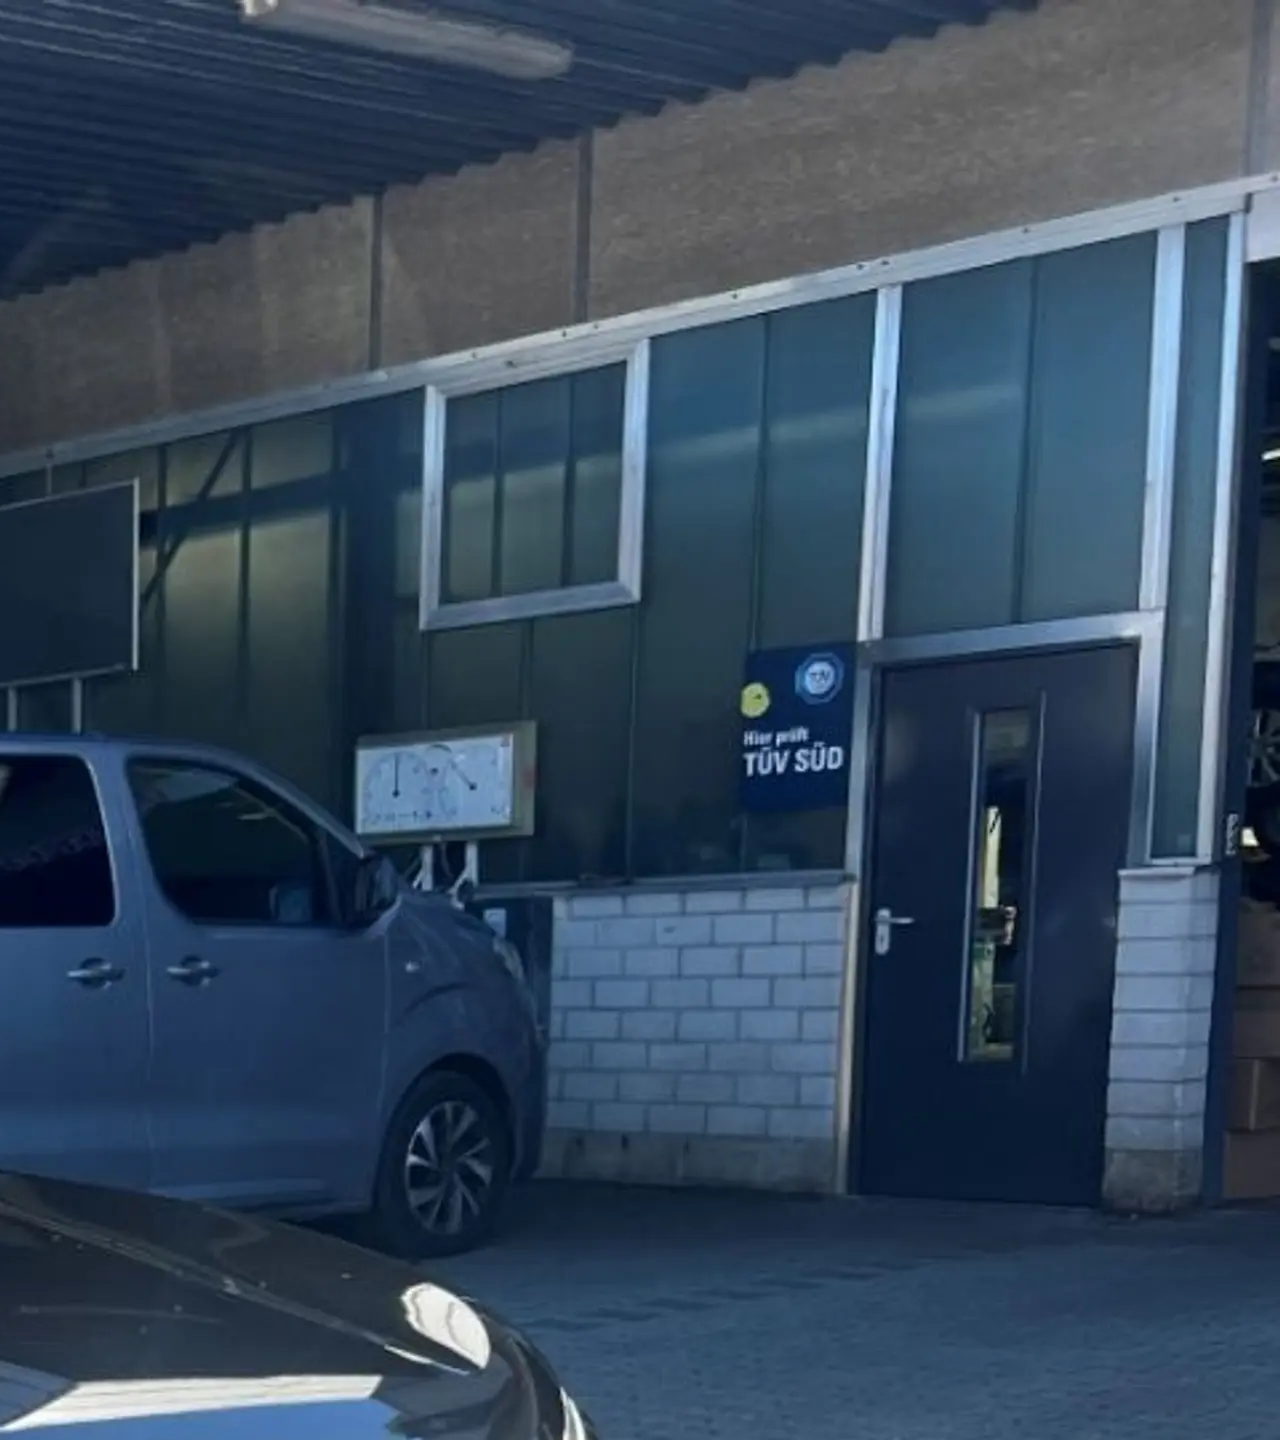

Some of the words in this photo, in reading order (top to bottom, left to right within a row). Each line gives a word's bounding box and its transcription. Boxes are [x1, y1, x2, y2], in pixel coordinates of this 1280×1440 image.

[744, 730, 772, 746] Hier
[743, 747, 790, 777] TÜV
[795, 741, 844, 773] SÜD
